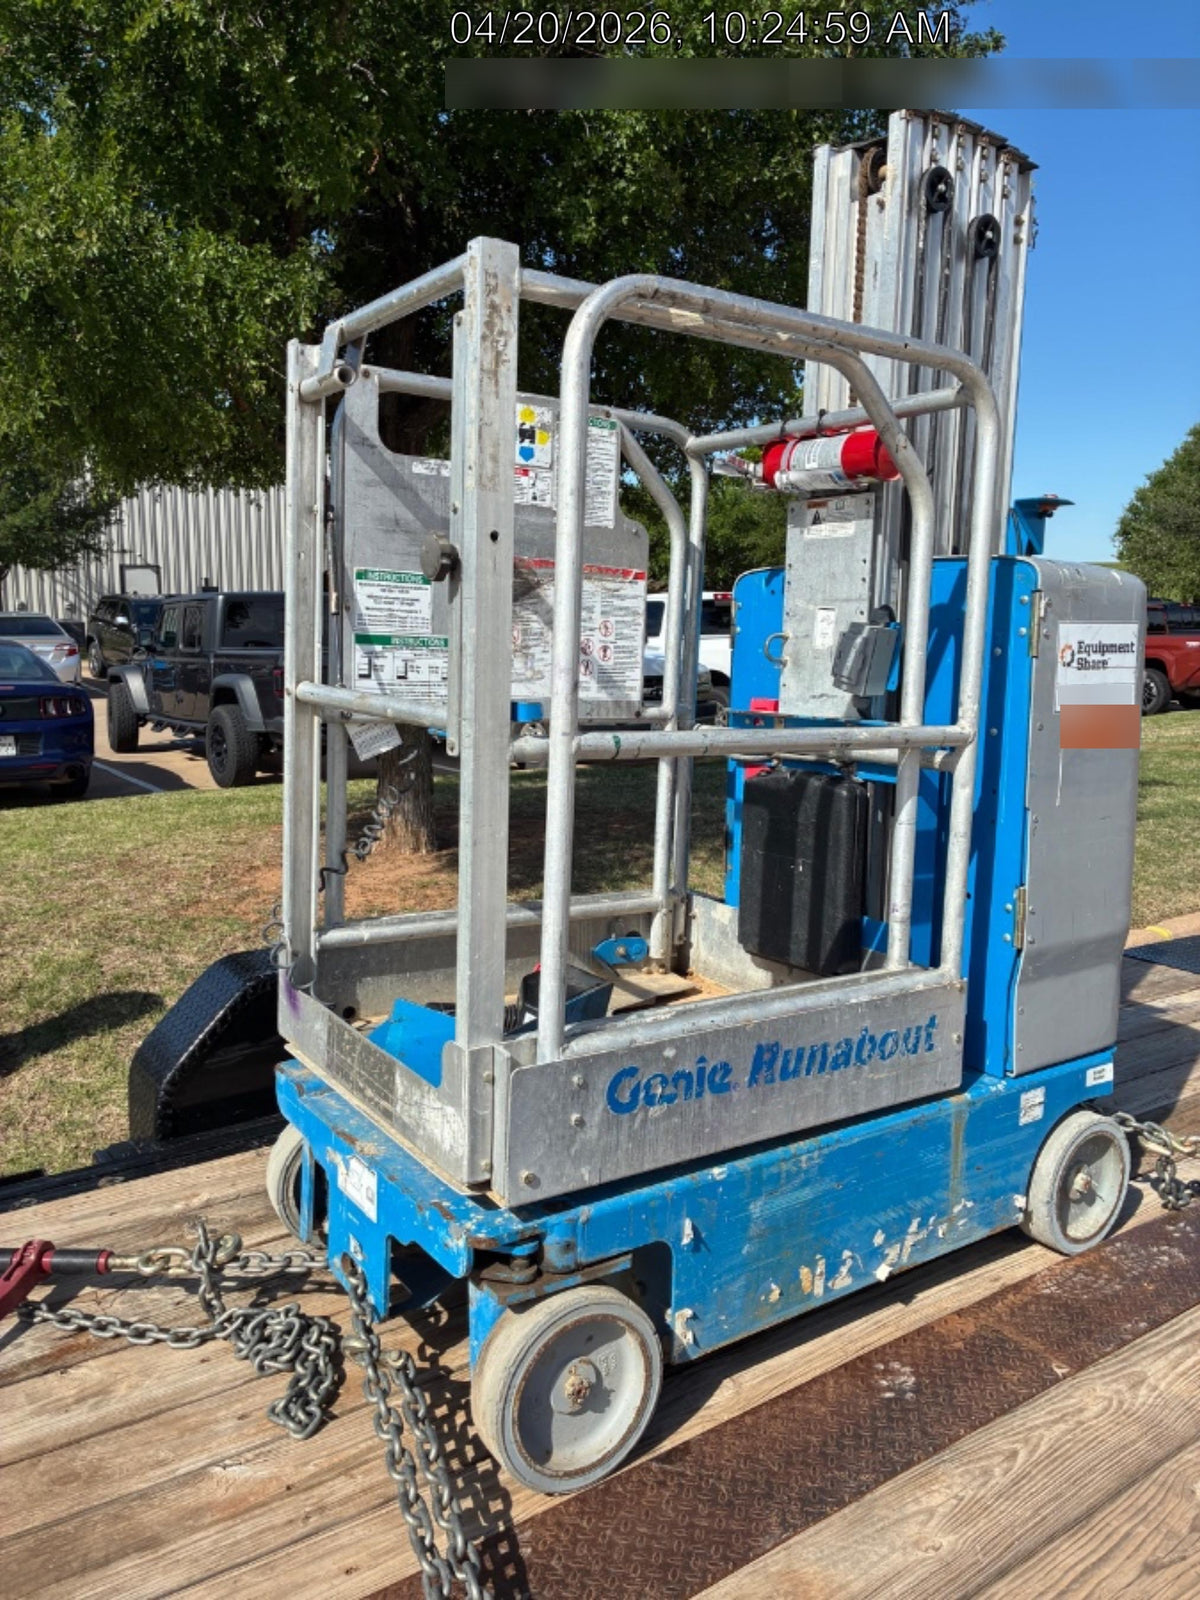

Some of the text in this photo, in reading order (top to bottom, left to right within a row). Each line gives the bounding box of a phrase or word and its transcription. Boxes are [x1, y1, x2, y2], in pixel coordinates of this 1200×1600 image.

[1077, 640, 1135, 656] Equipment
[1077, 657, 1109, 671] Share
[606, 1014, 938, 1115] Genie Runabout
